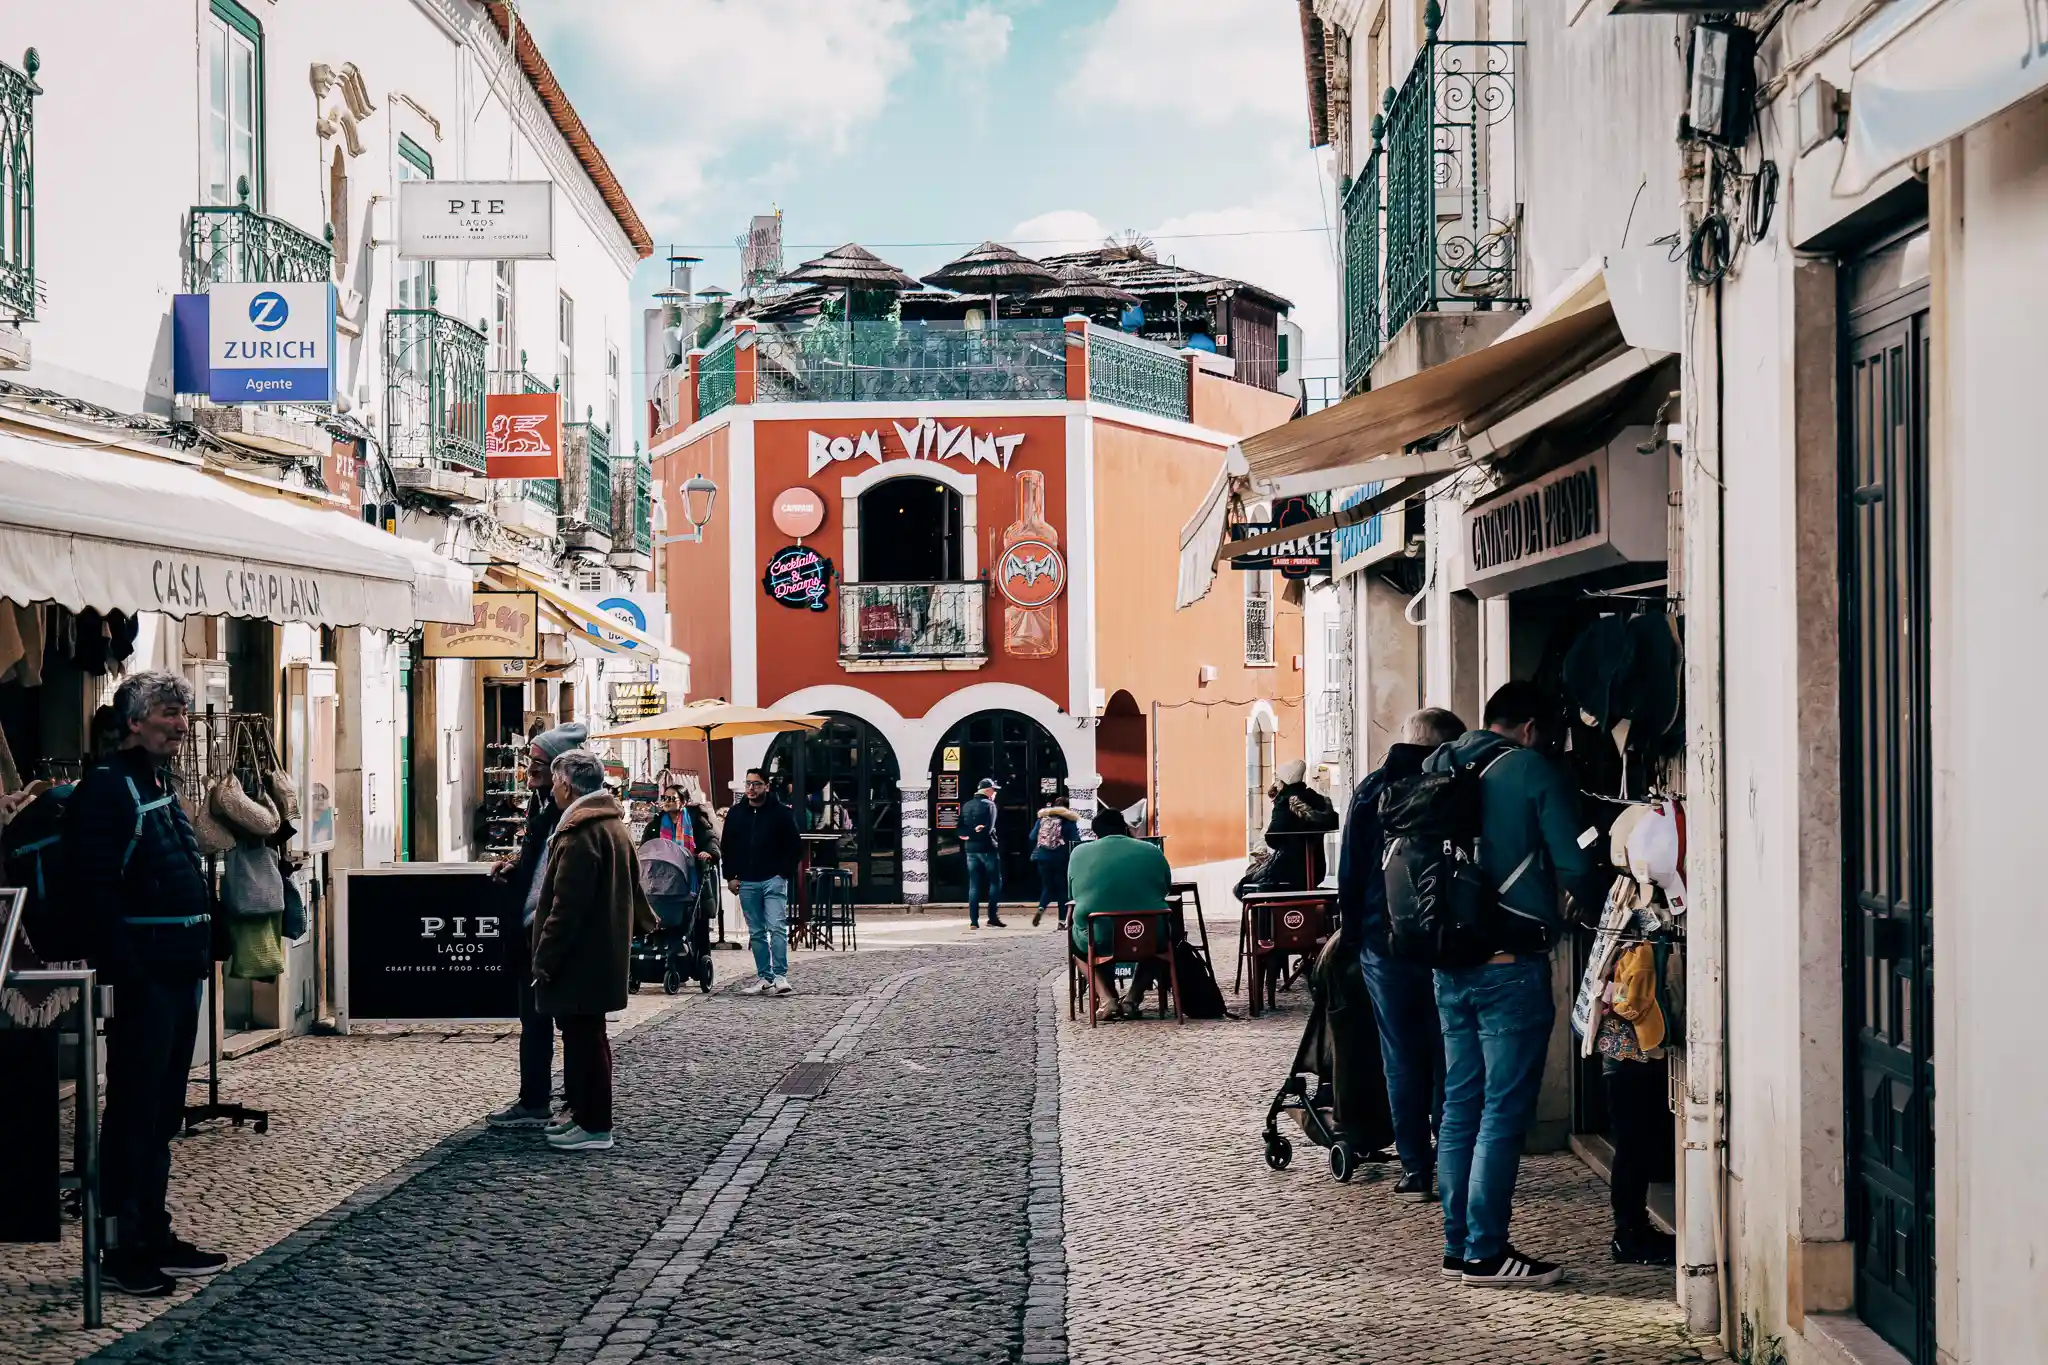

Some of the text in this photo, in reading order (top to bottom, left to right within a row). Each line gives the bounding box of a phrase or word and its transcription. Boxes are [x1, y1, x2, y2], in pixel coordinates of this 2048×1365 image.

[448, 199, 505, 214] PIE
[460, 219, 494, 227] LAGOS
[223, 341, 315, 359] ZURICH
[245, 378, 293, 392] Agente
[1472, 464, 1600, 571] CANTINHO DA PRENDA
[770, 551, 819, 577] Cocktails
[790, 570, 803, 582] &
[152, 559, 324, 617] CASA CATAPLANA
[774, 576, 821, 599] Dreams
[420, 916, 500, 938] PIE
[437, 943, 484, 953] LAGOS
